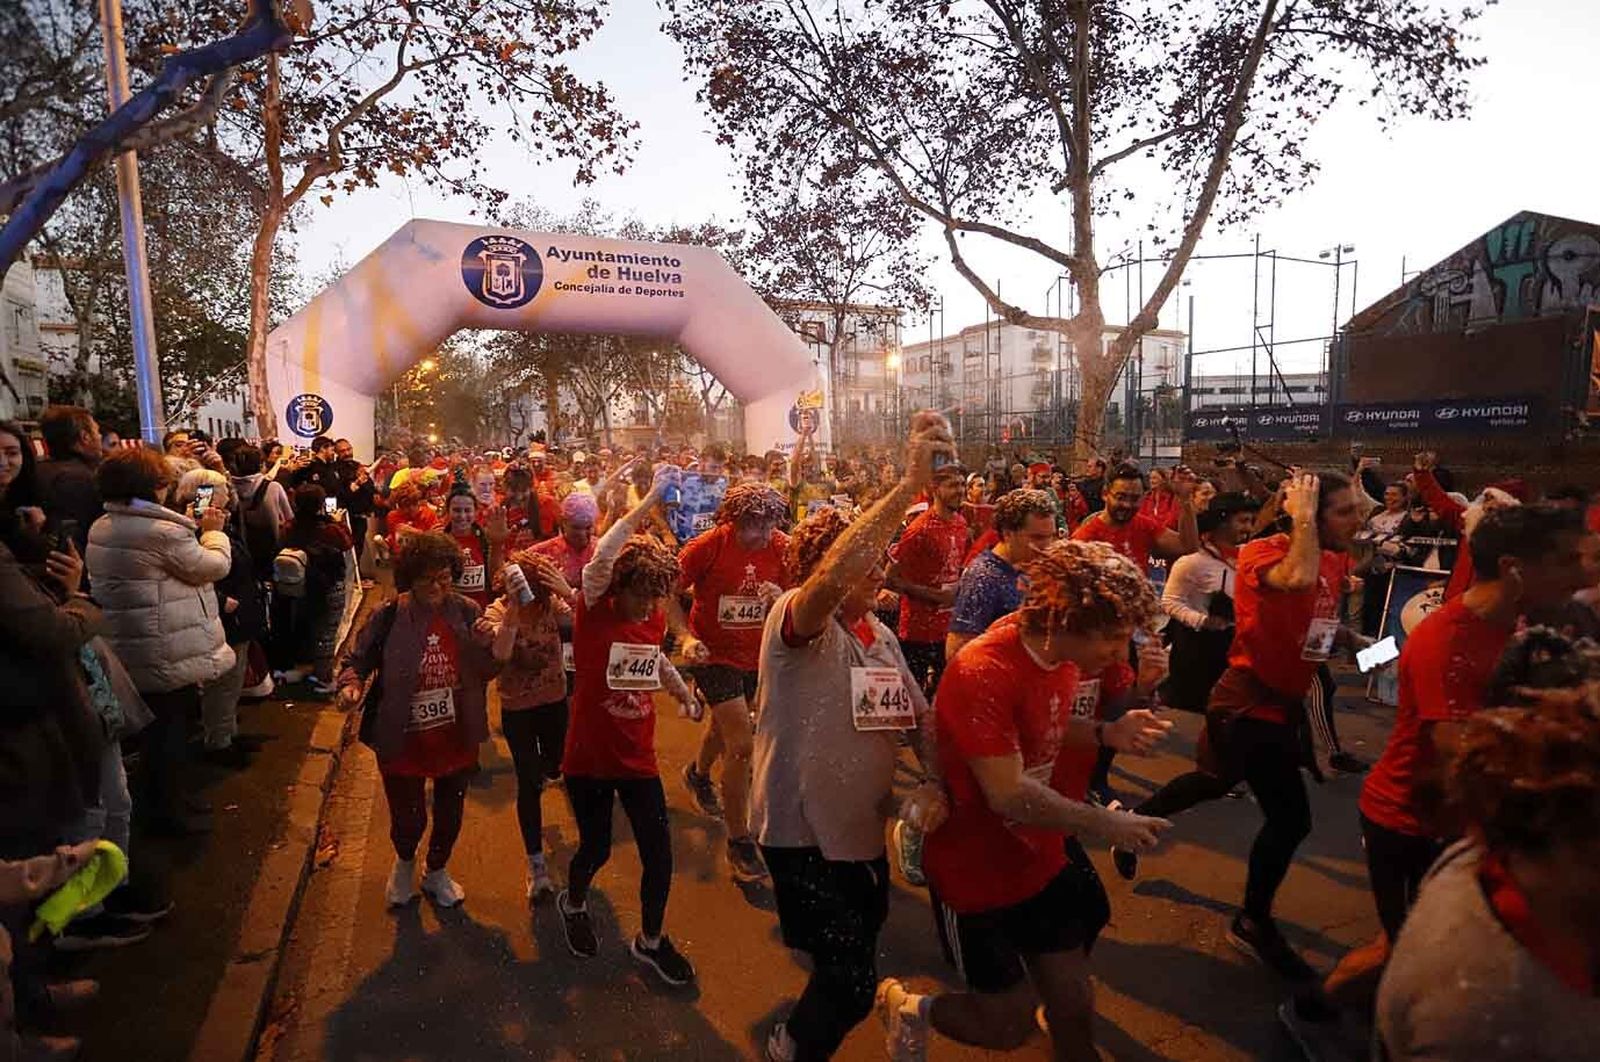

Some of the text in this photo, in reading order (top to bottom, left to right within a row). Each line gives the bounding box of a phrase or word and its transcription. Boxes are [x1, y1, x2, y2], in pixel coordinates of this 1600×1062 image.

[546, 246, 681, 268] Ayuntamiento
[587, 265, 682, 284] de Huelva
[618, 286, 632, 295] de
[635, 286, 684, 298] Deportes
[1366, 410, 1420, 421] HYUNDAI
[1462, 405, 1528, 417] HYUNDAI
[1275, 413, 1320, 423] HYUNDAI
[463, 574, 482, 585] 517
[738, 606, 761, 619] 442
[629, 659, 655, 677] 448
[880, 686, 909, 712] 449
[418, 700, 448, 719] 398
